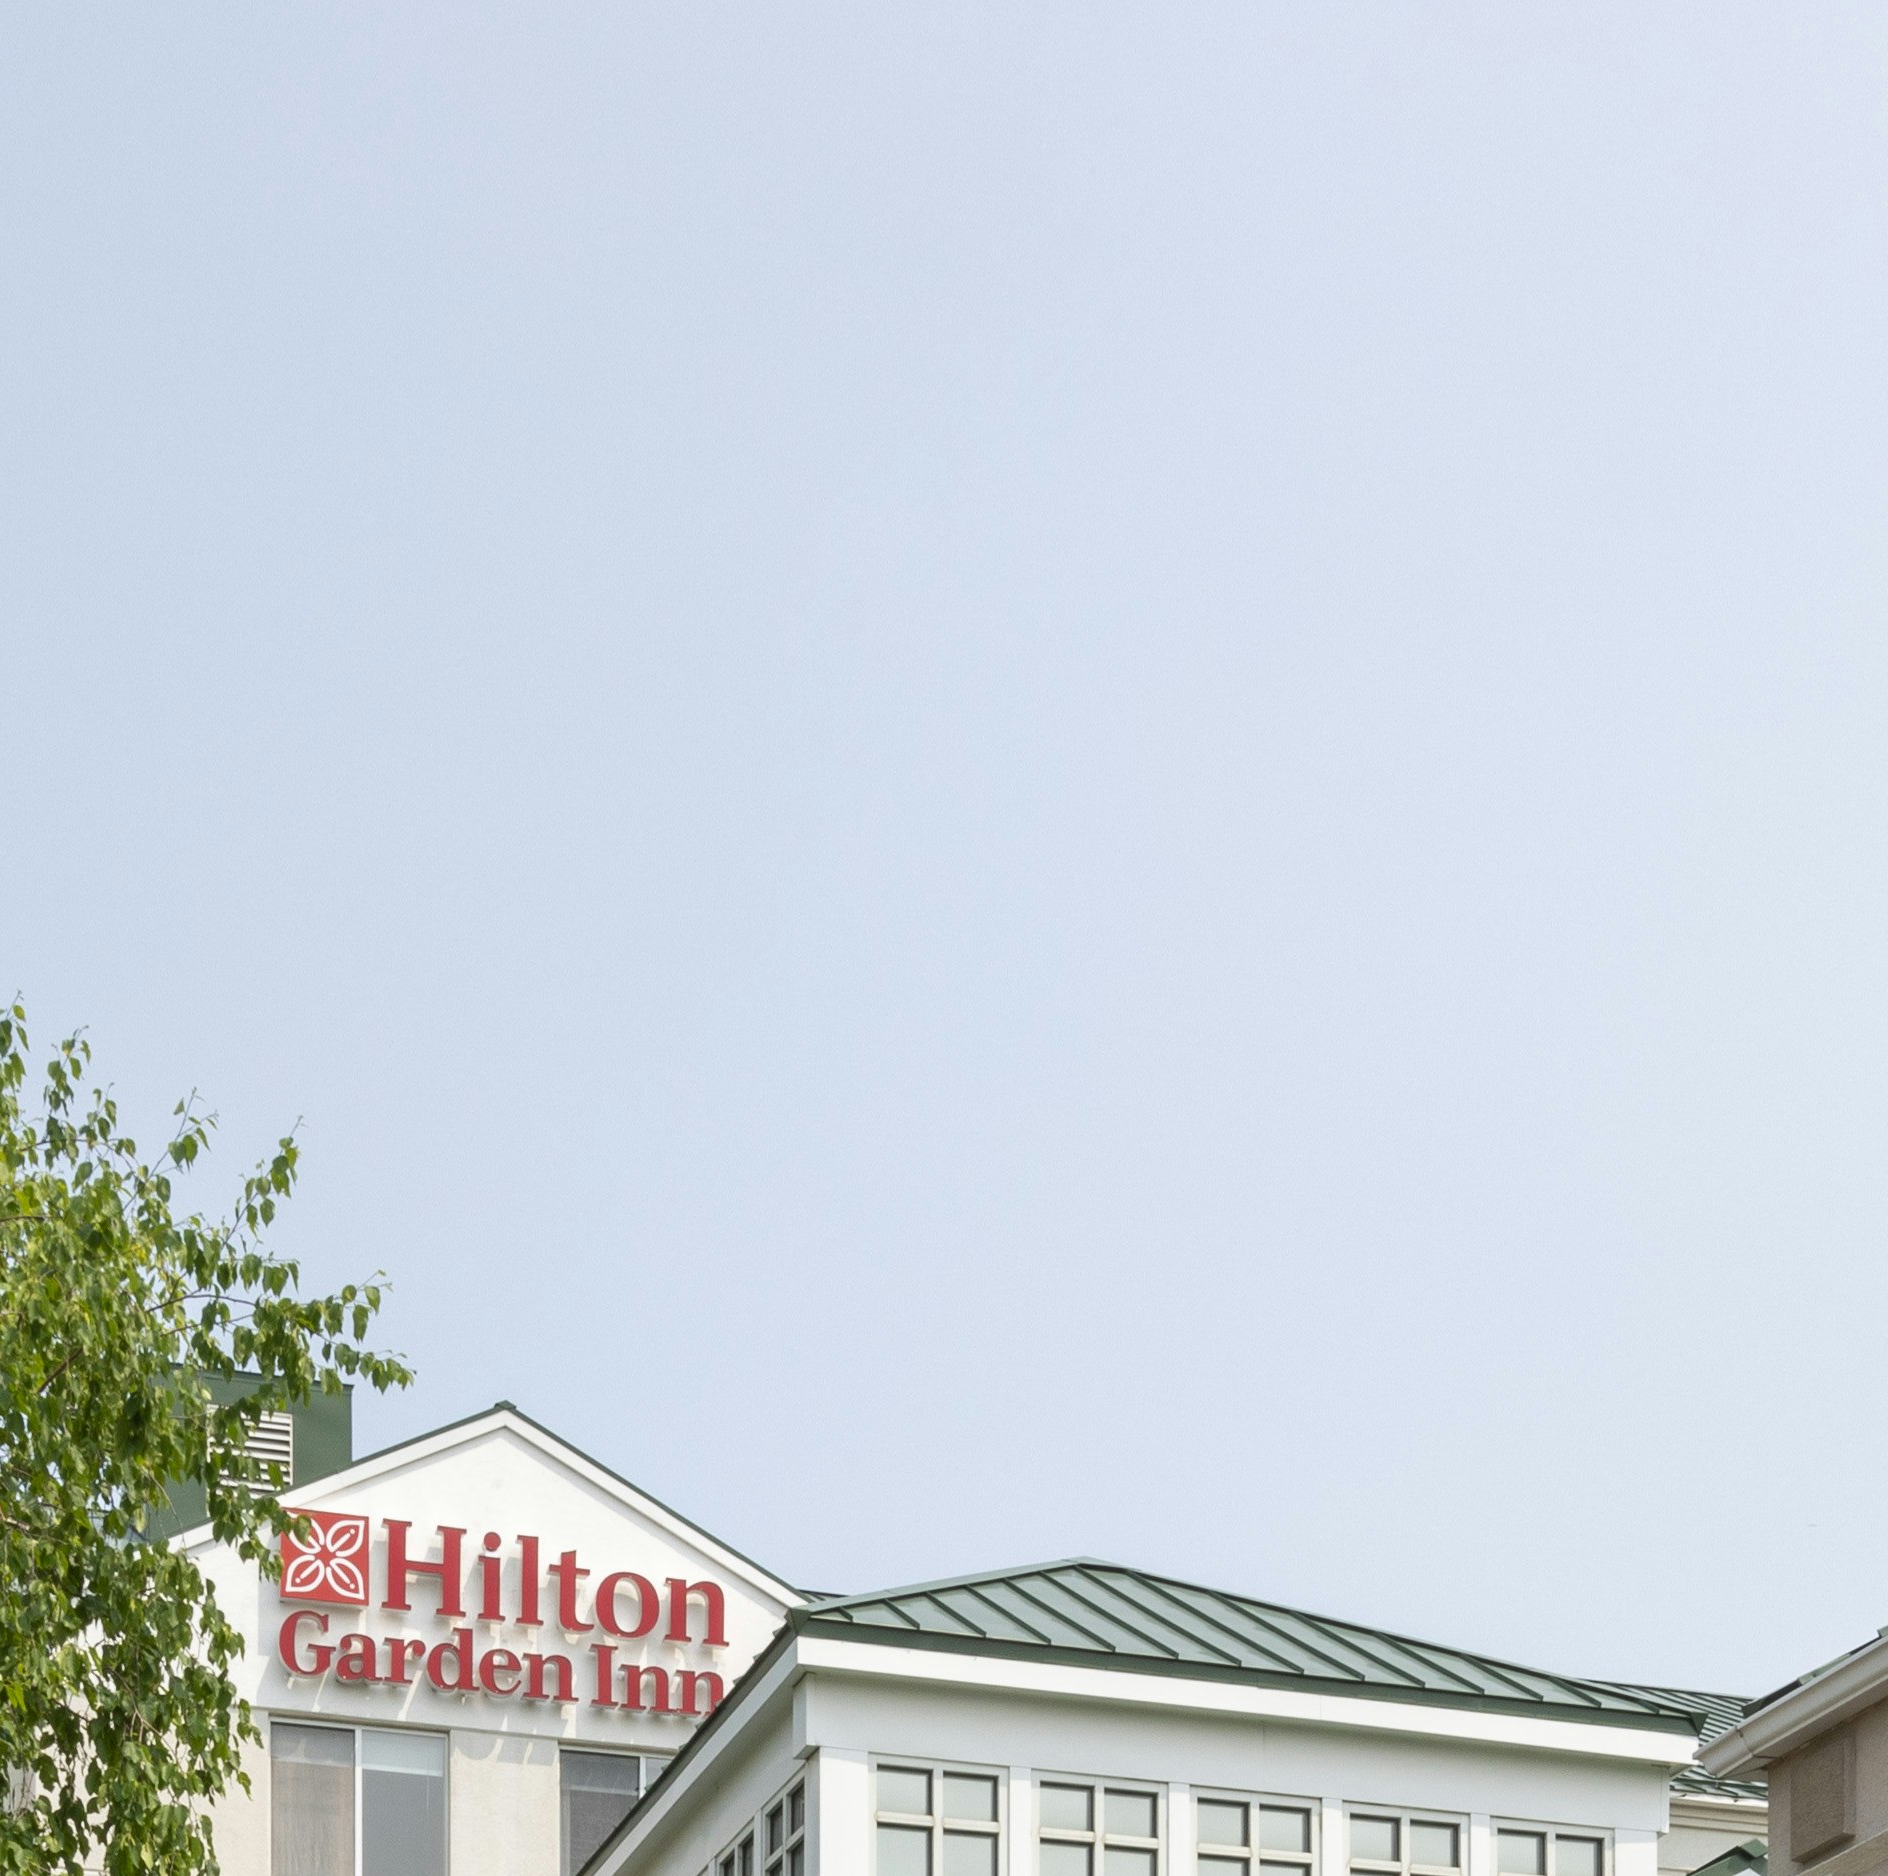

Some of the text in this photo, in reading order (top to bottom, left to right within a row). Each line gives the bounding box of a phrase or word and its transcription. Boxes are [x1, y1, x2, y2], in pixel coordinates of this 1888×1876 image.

[381, 1518, 729, 1647] Hilton
[278, 1610, 725, 1717] Garden Inn
